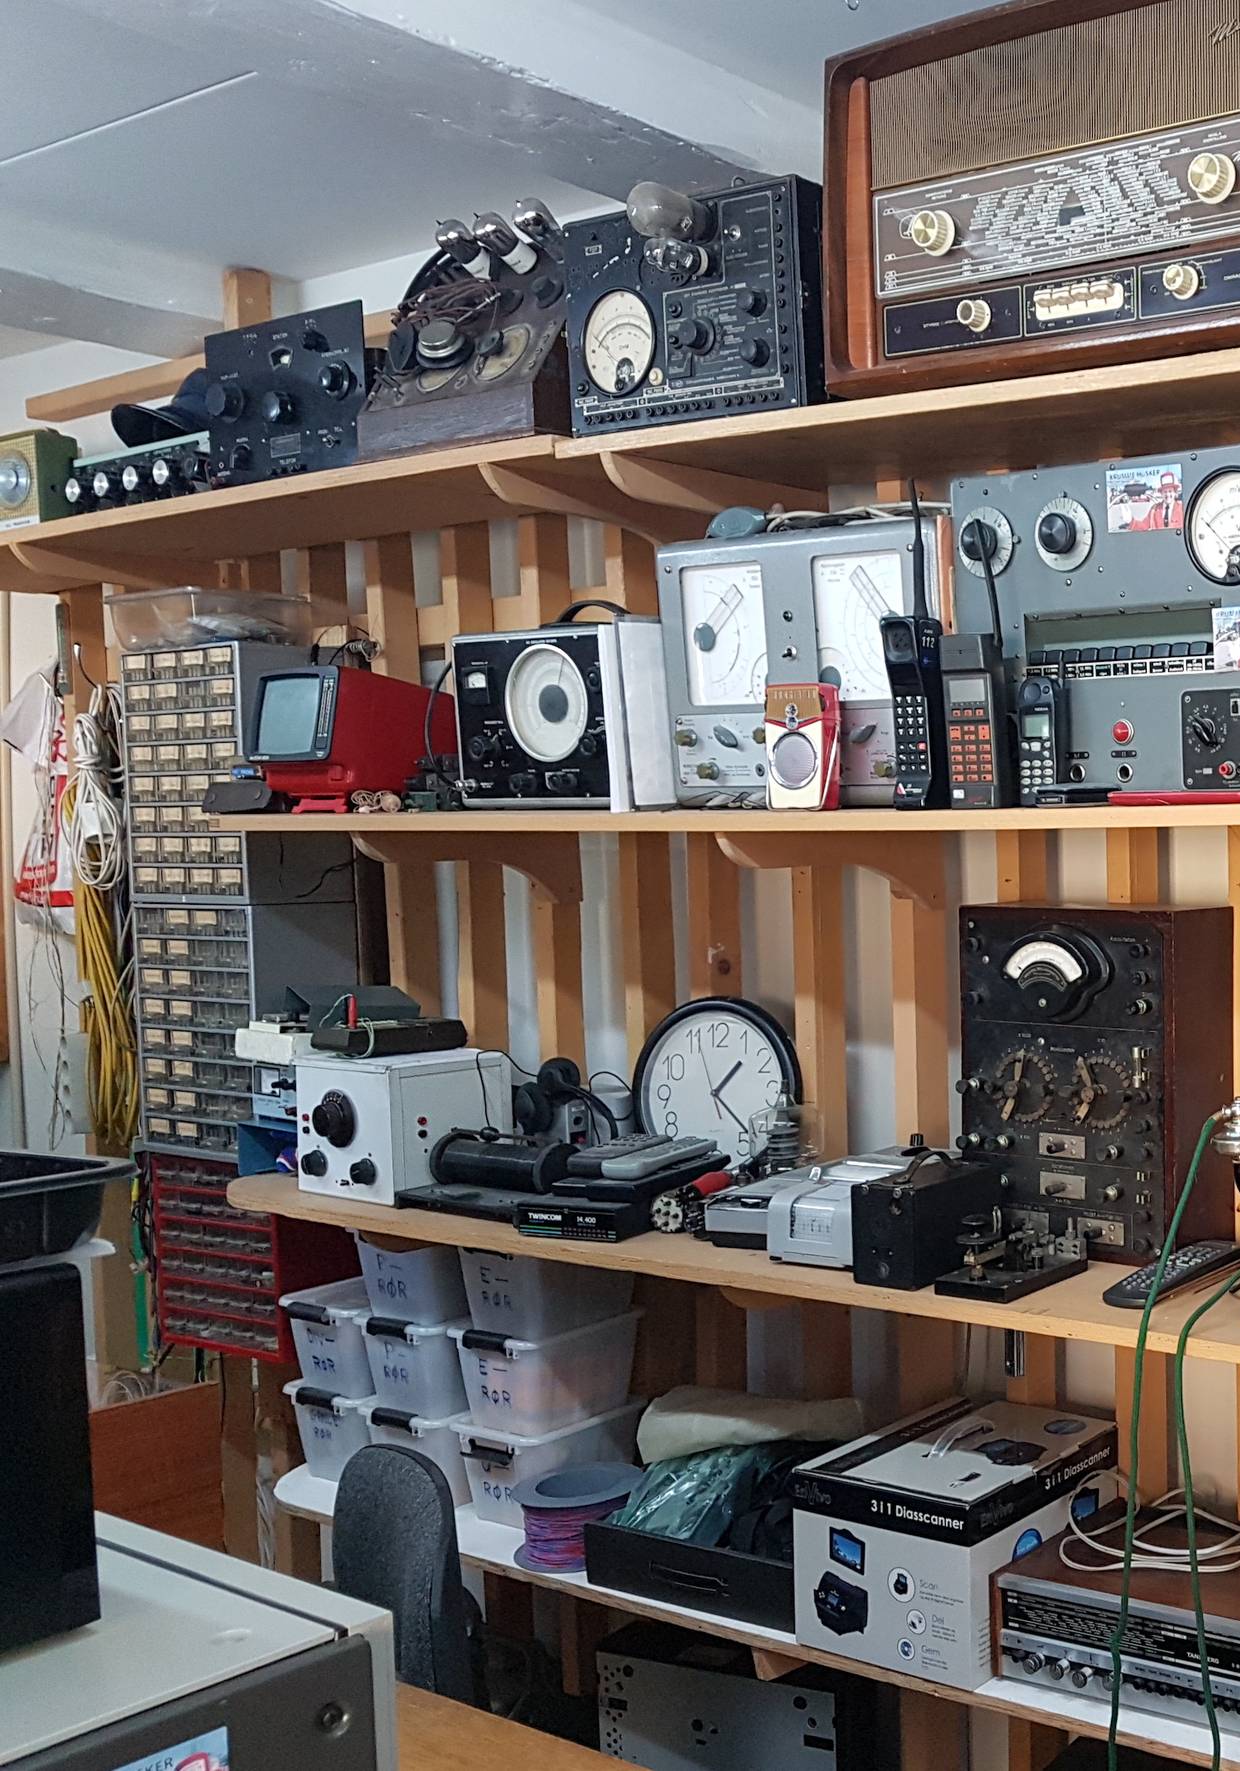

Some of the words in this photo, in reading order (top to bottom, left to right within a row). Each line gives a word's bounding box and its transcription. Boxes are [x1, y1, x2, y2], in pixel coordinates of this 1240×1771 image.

[921, 636, 935, 648] 112
[686, 1028, 701, 1054] 11
[707, 1022, 730, 1048] 12
[740, 1030, 748, 1054] 1
[662, 1054, 685, 1080] 10
[756, 1048, 772, 1073] 2
[657, 1084, 672, 1109] 9
[665, 1112, 678, 1138] 8
[737, 1132, 750, 1156] 5
[528, 1212, 562, 1221] TWINCOM
[377, 1276, 408, 1299] RØR
[482, 1290, 512, 1310] RØR
[384, 1365, 409, 1384] RØR
[480, 1385, 512, 1408] RØR
[1044, 1478, 1051, 1490] 3
[1057, 1472, 1062, 1484] 1
[1063, 1446, 1111, 1480] Diasscanner
[482, 1481, 512, 1500] RØR
[870, 1500, 878, 1512] 3
[886, 1503, 892, 1516] 1
[895, 1506, 964, 1530] Diasscanner
[1186, 1652, 1220, 1665] TANERG
